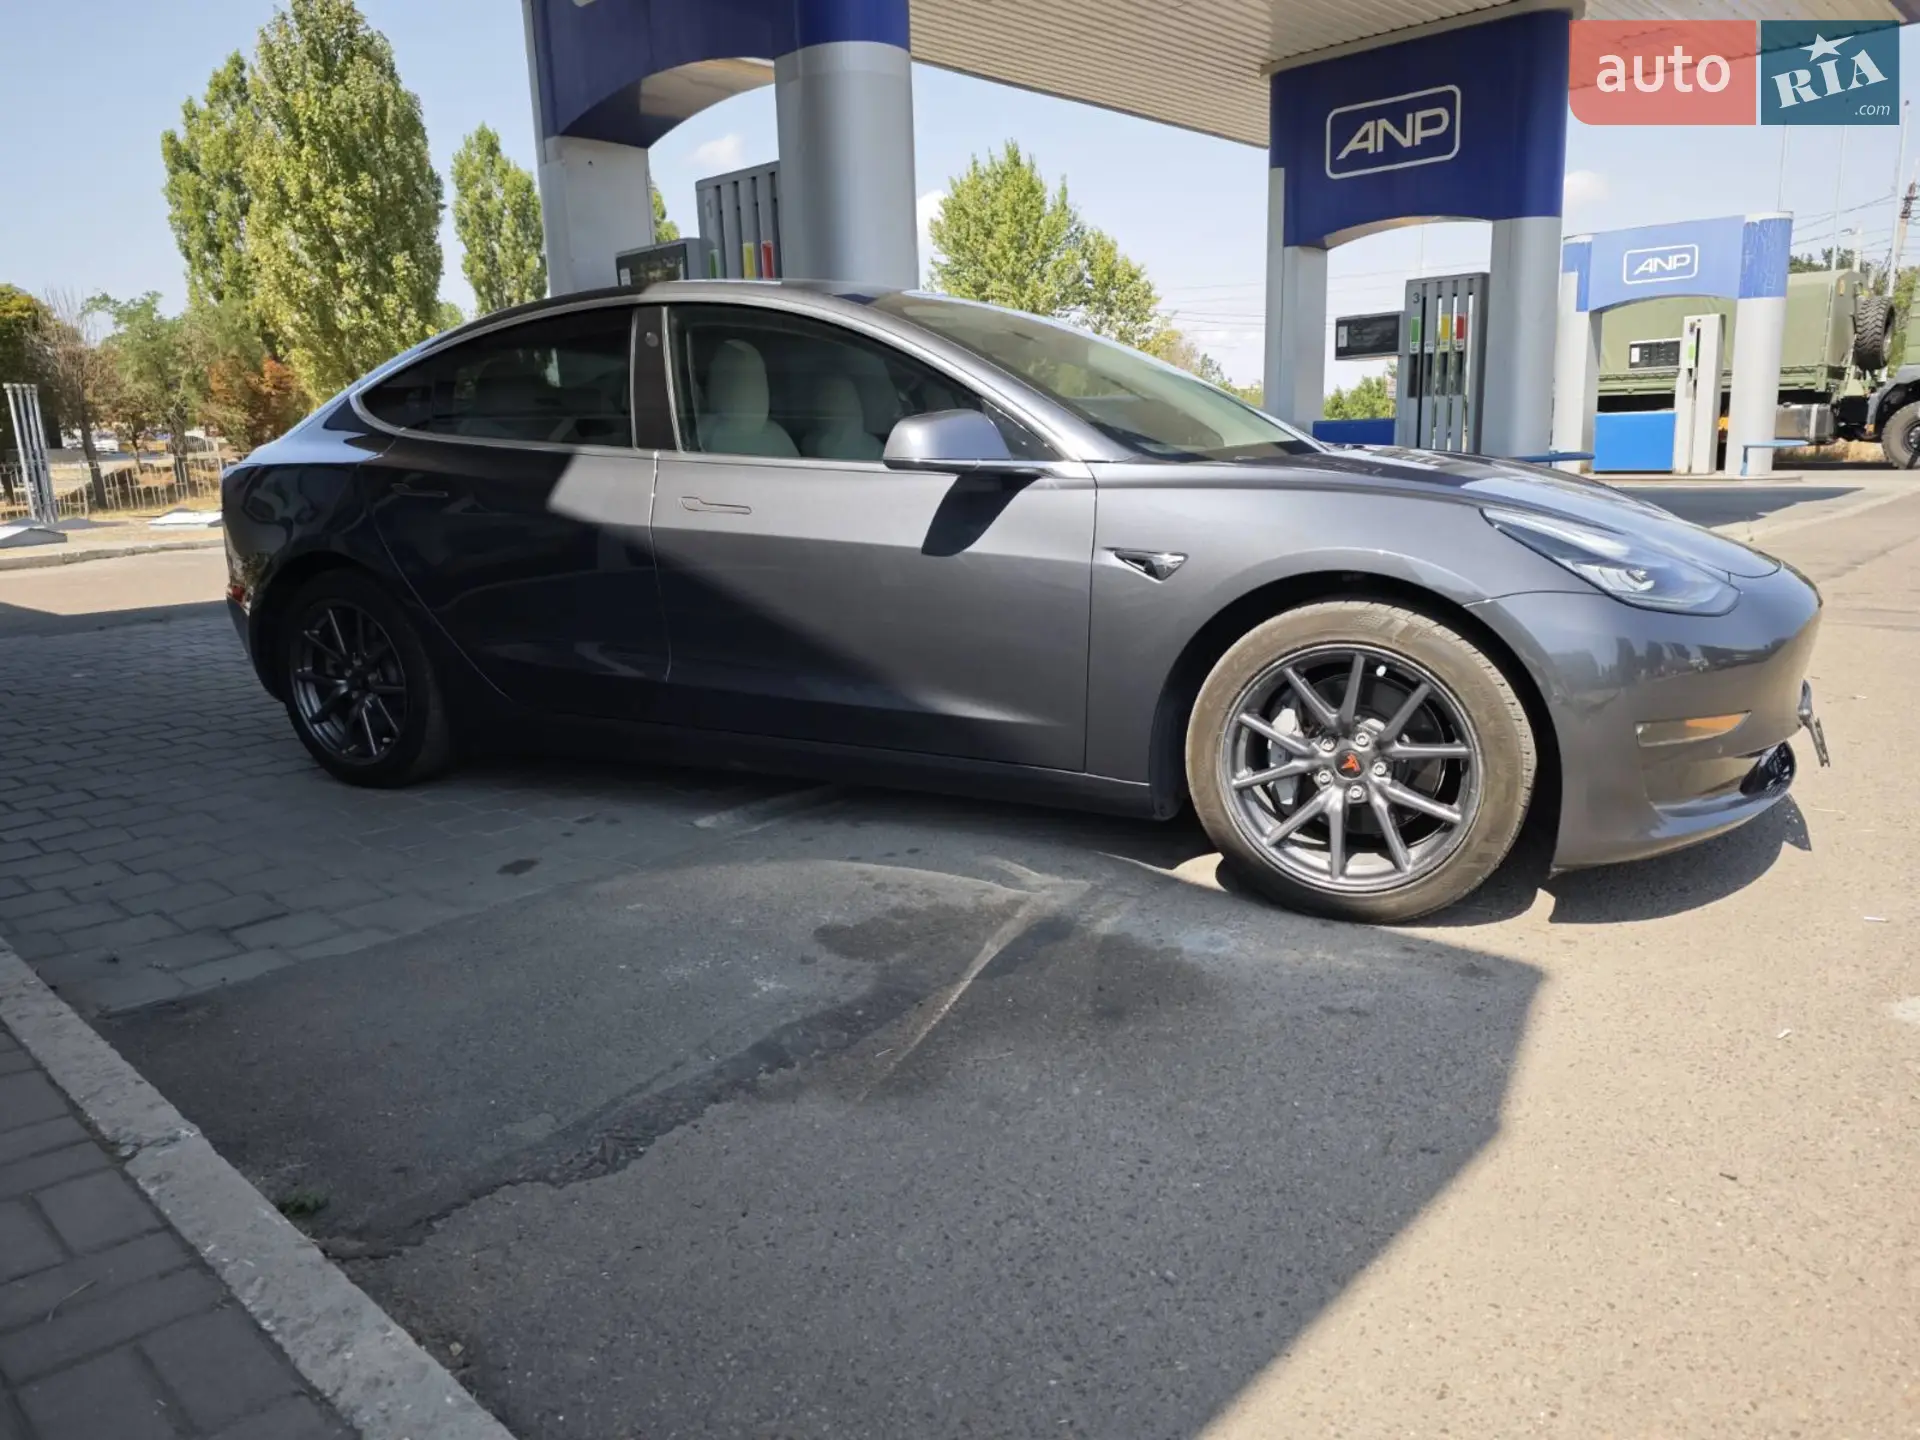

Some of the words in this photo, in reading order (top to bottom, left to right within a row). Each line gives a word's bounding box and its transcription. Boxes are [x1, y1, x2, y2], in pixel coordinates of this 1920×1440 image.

[1336, 107, 1449, 160] ANP
[1634, 253, 1691, 275] ANP
[1412, 292, 1421, 304] 3
